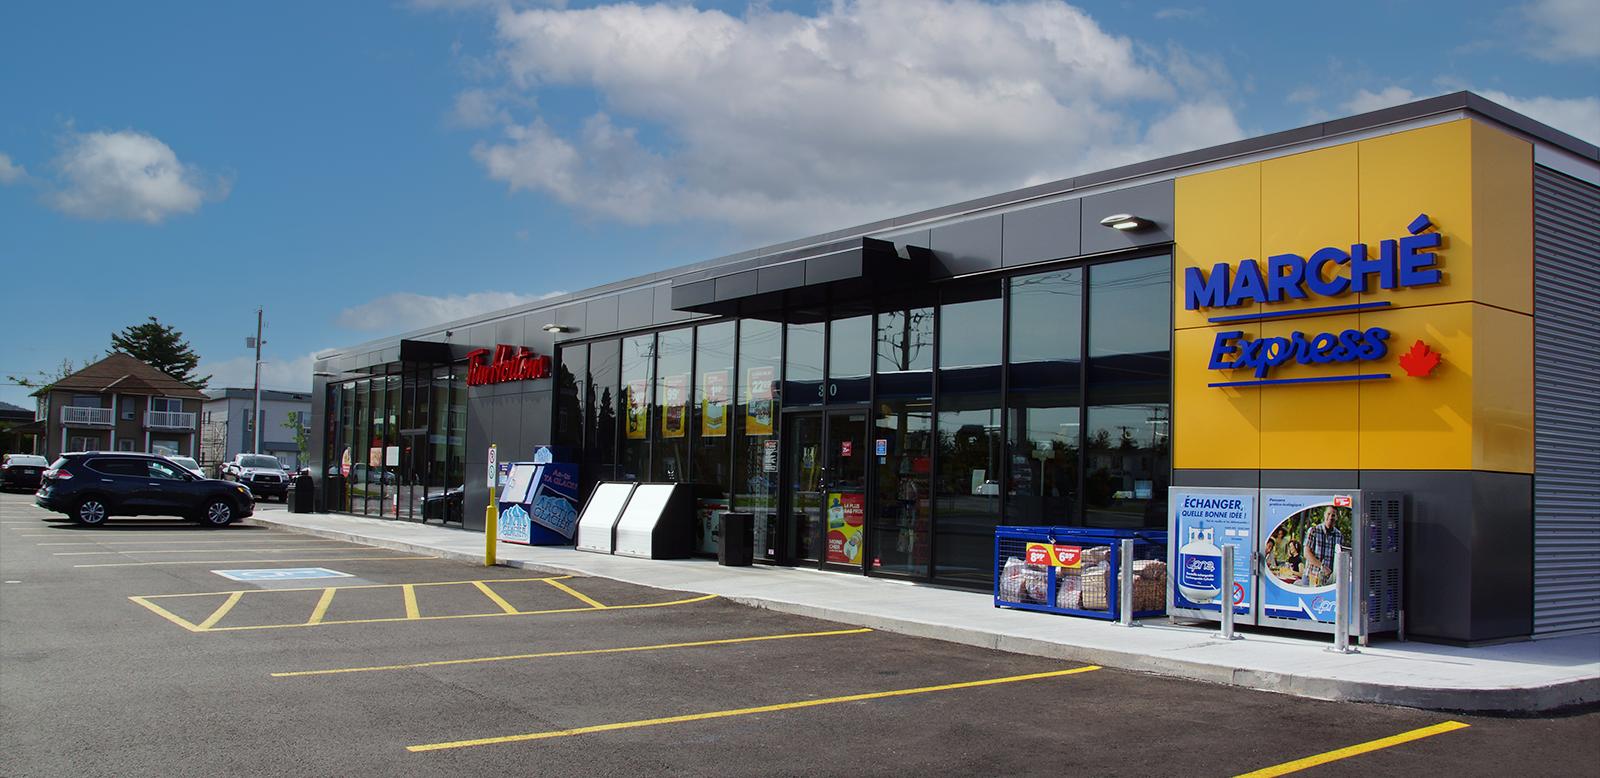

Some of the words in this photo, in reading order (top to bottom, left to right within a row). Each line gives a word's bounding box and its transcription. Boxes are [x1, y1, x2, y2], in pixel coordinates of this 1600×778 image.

[1185, 213, 1442, 310] MARCHÉ
[1208, 327, 1392, 378] Express
[536, 497, 577, 522] ARCTIC
[1184, 495, 1244, 511] ÉCHANGER,
[534, 507, 571, 531] GLACIER
